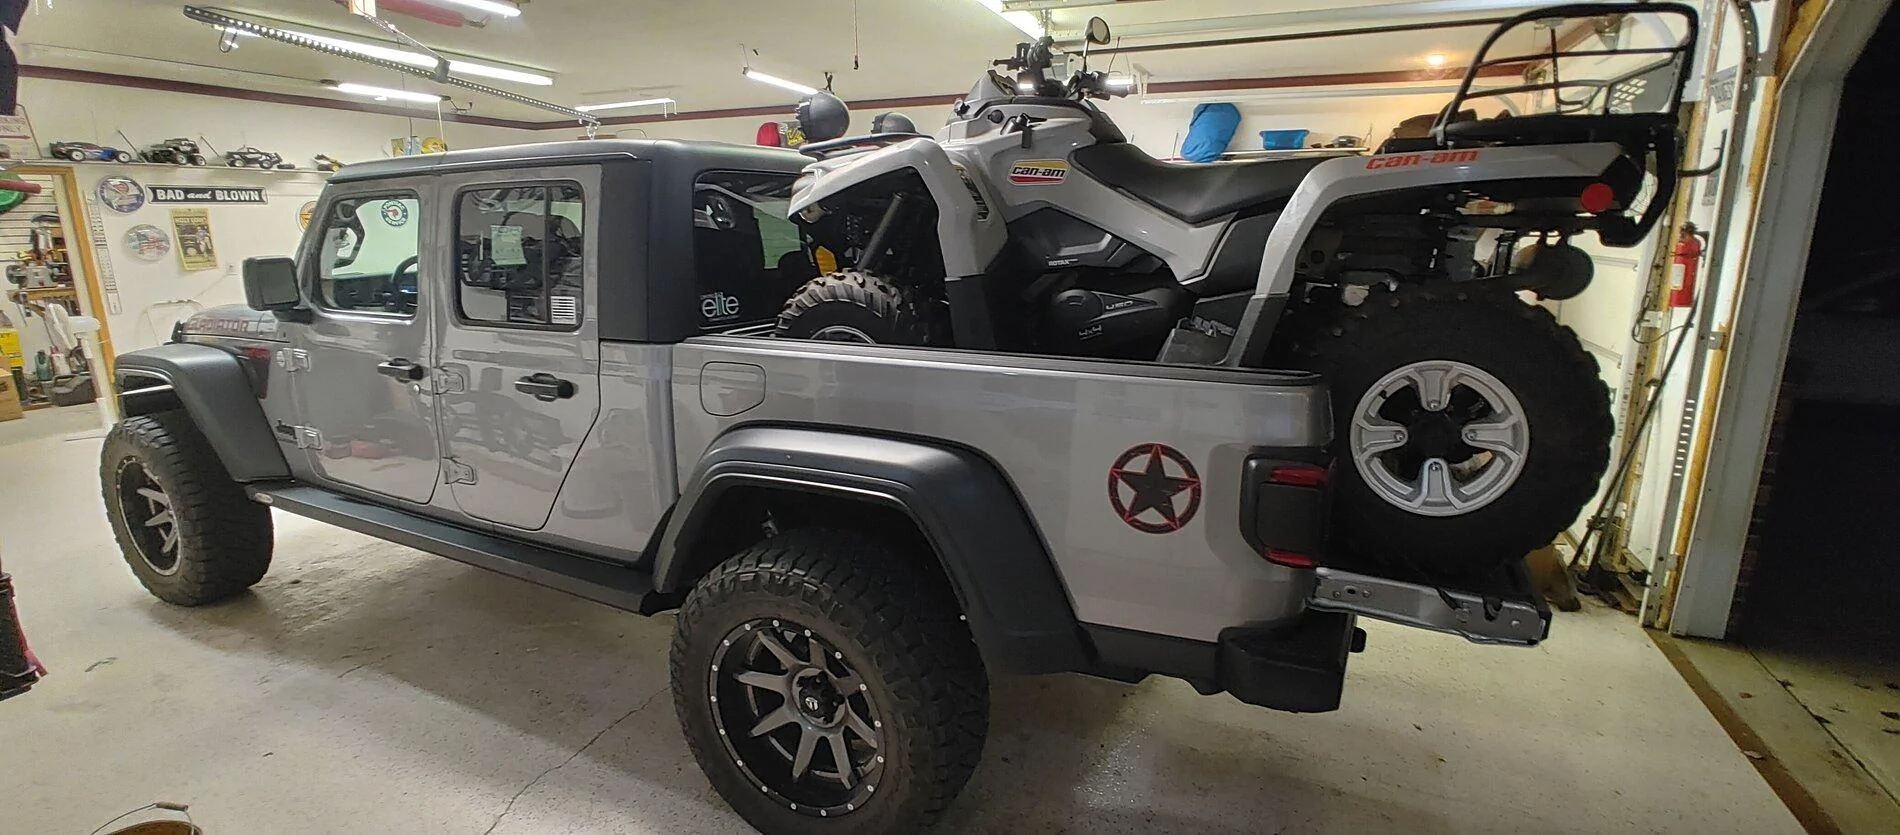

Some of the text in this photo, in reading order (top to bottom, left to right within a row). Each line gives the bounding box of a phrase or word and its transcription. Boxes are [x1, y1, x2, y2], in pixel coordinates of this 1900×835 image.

[1366, 150, 1479, 170] can-am
[1012, 166, 1066, 177] can-am
[156, 189, 260, 201] BAD and BLOWN
[702, 292, 739, 318] elite
